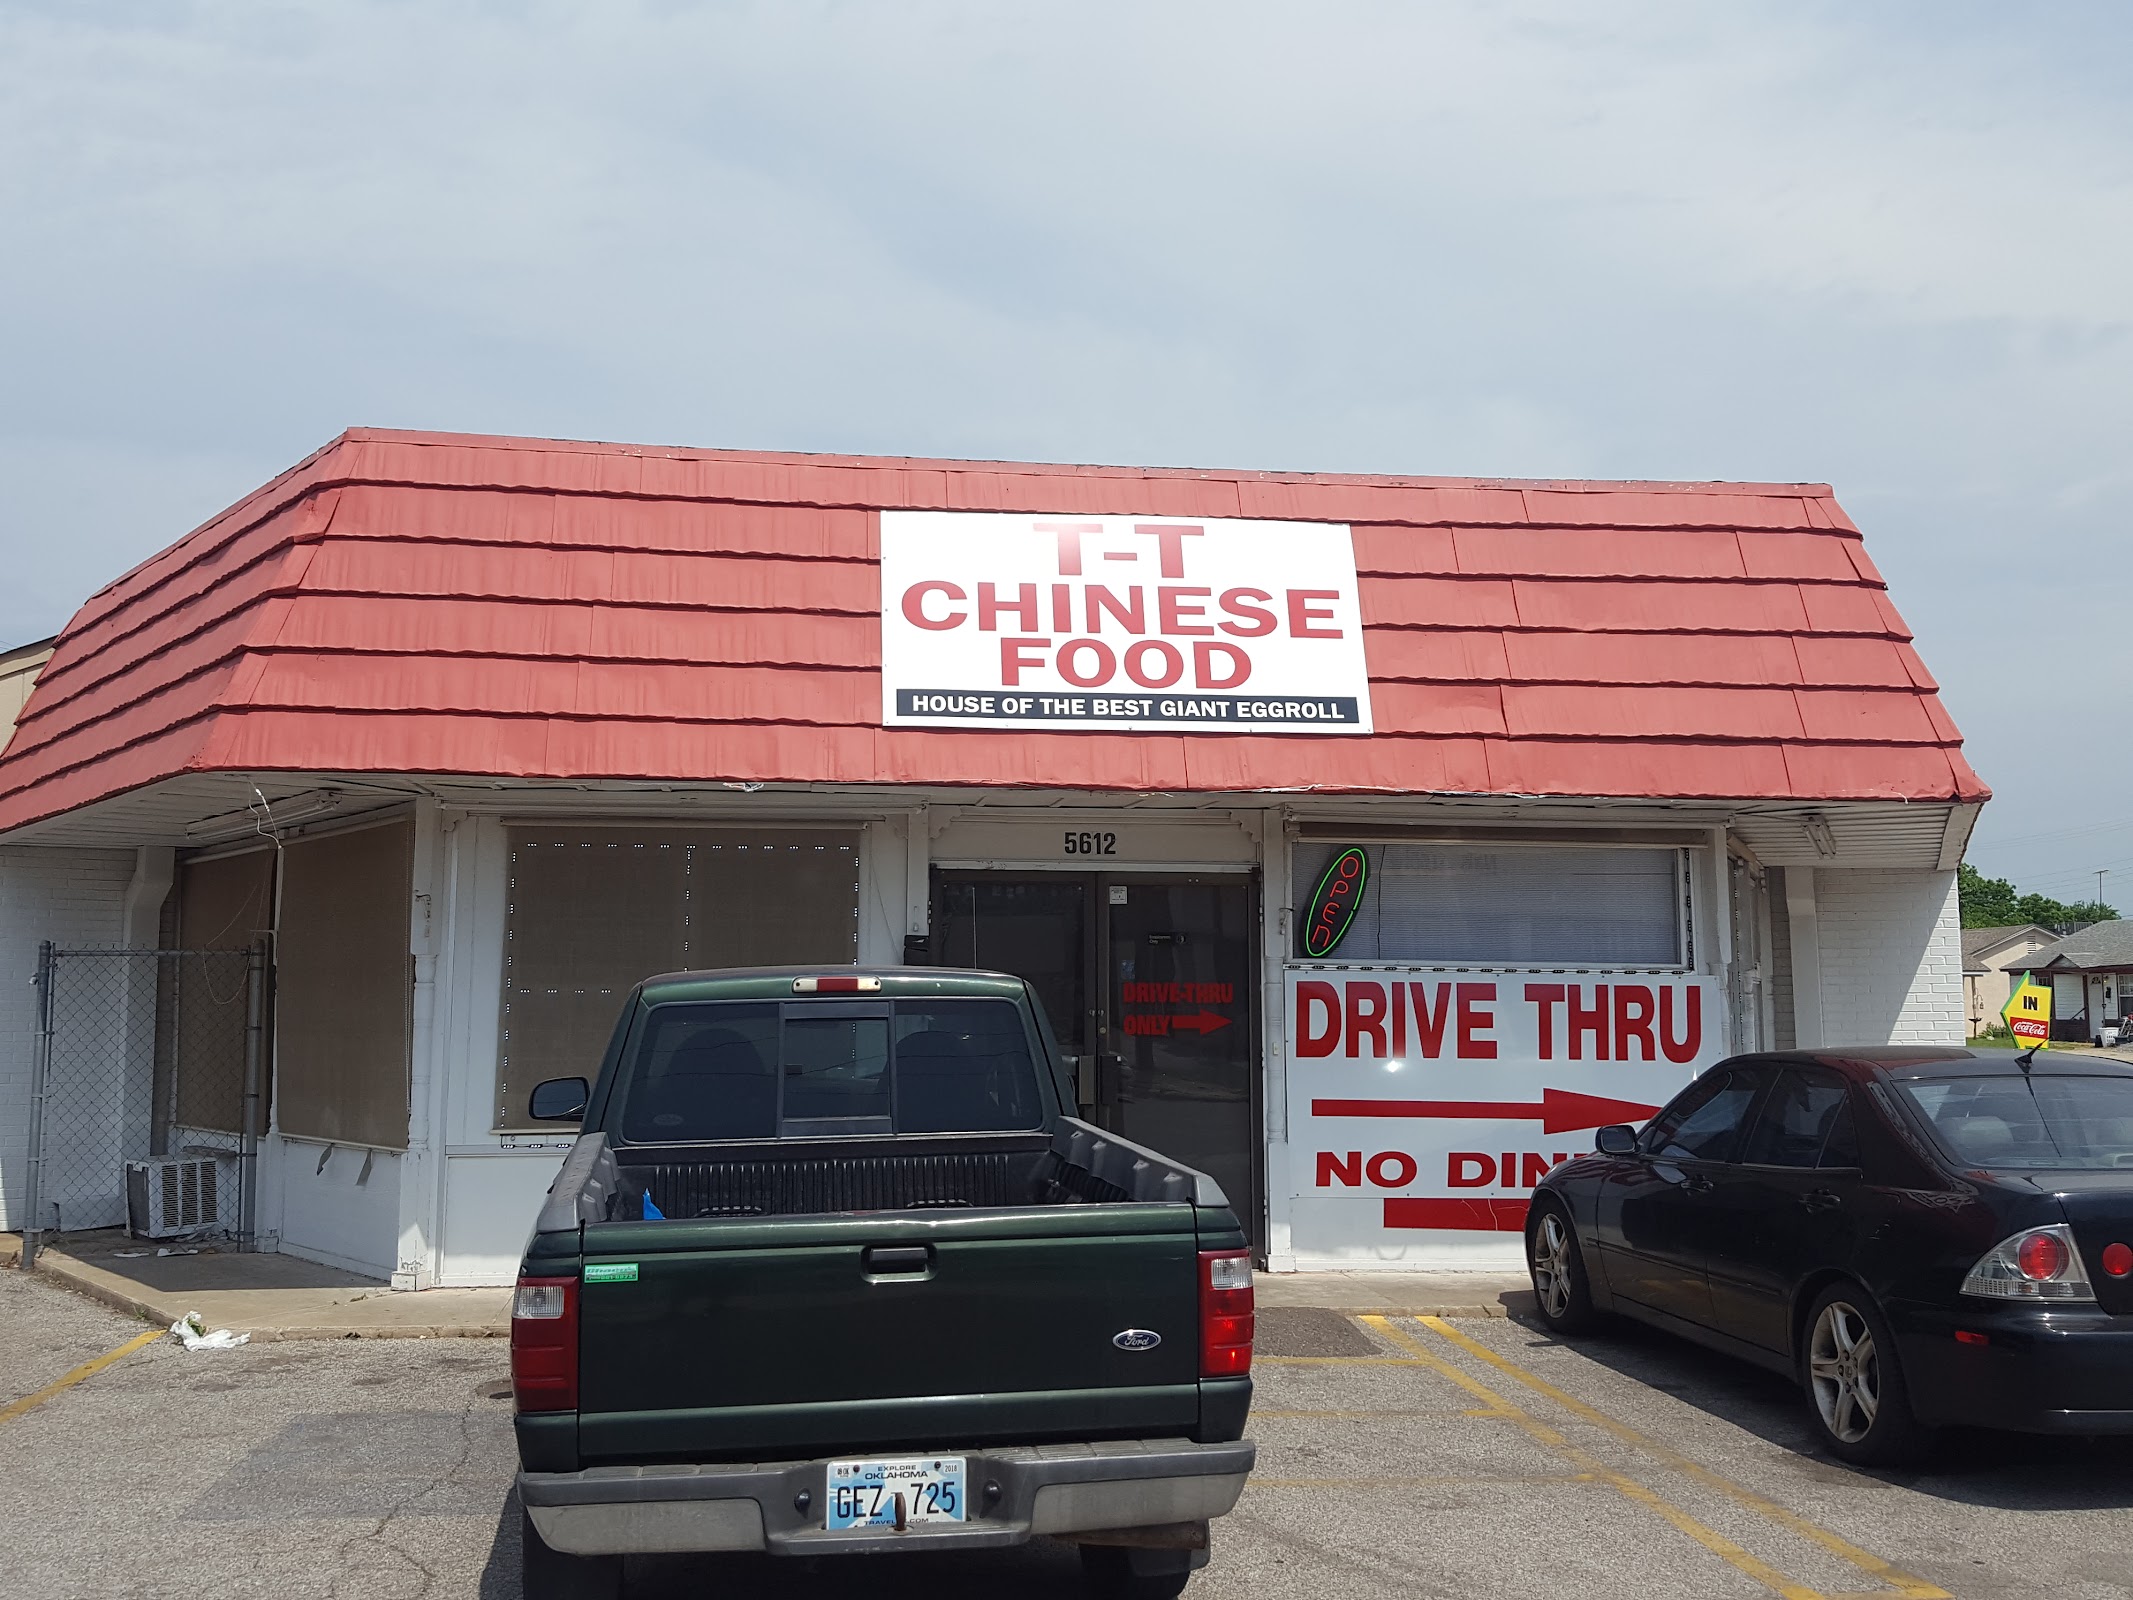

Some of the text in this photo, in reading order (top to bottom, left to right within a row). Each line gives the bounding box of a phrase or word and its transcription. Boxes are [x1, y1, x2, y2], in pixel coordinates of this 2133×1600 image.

[1033, 522, 1204, 578] T-T
[901, 580, 1344, 639] CHINESE
[1000, 637, 1252, 689] FOOD
[912, 694, 1345, 720] HOUSE OF THE BEST GIANT EGGROLL
[1065, 832, 1116, 855] 5612
[1312, 856, 1359, 947] OPEN
[1123, 982, 1233, 1004] DRIVE-THRU
[2023, 995, 2038, 1011] IN
[1123, 1015, 1171, 1036] ONLY
[1296, 980, 1702, 1064] DRIVE THRU
[2013, 1021, 2047, 1036] Coca-Cola
[1315, 1151, 1590, 1188] NO DIN
[1124, 1334, 1150, 1346] Ford
[864, 1471, 929, 1480] OKLAHOMA
[837, 1481, 956, 1519] GEZ 725
